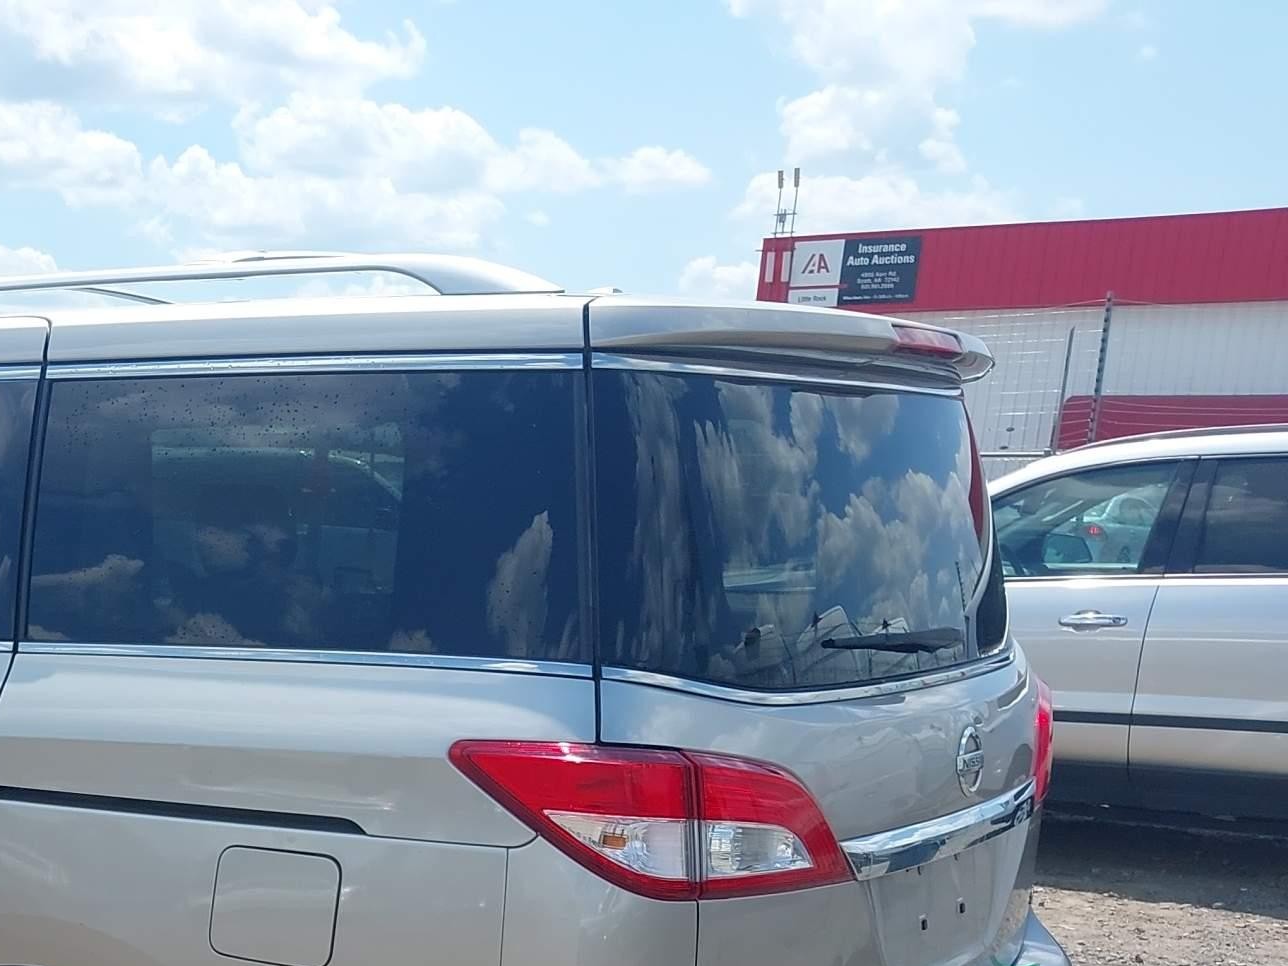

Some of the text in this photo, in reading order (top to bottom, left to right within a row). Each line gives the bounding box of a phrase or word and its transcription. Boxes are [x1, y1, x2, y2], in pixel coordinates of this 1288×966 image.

[858, 243, 907, 254] Insurance
[846, 253, 915, 266] Auto Auctions
